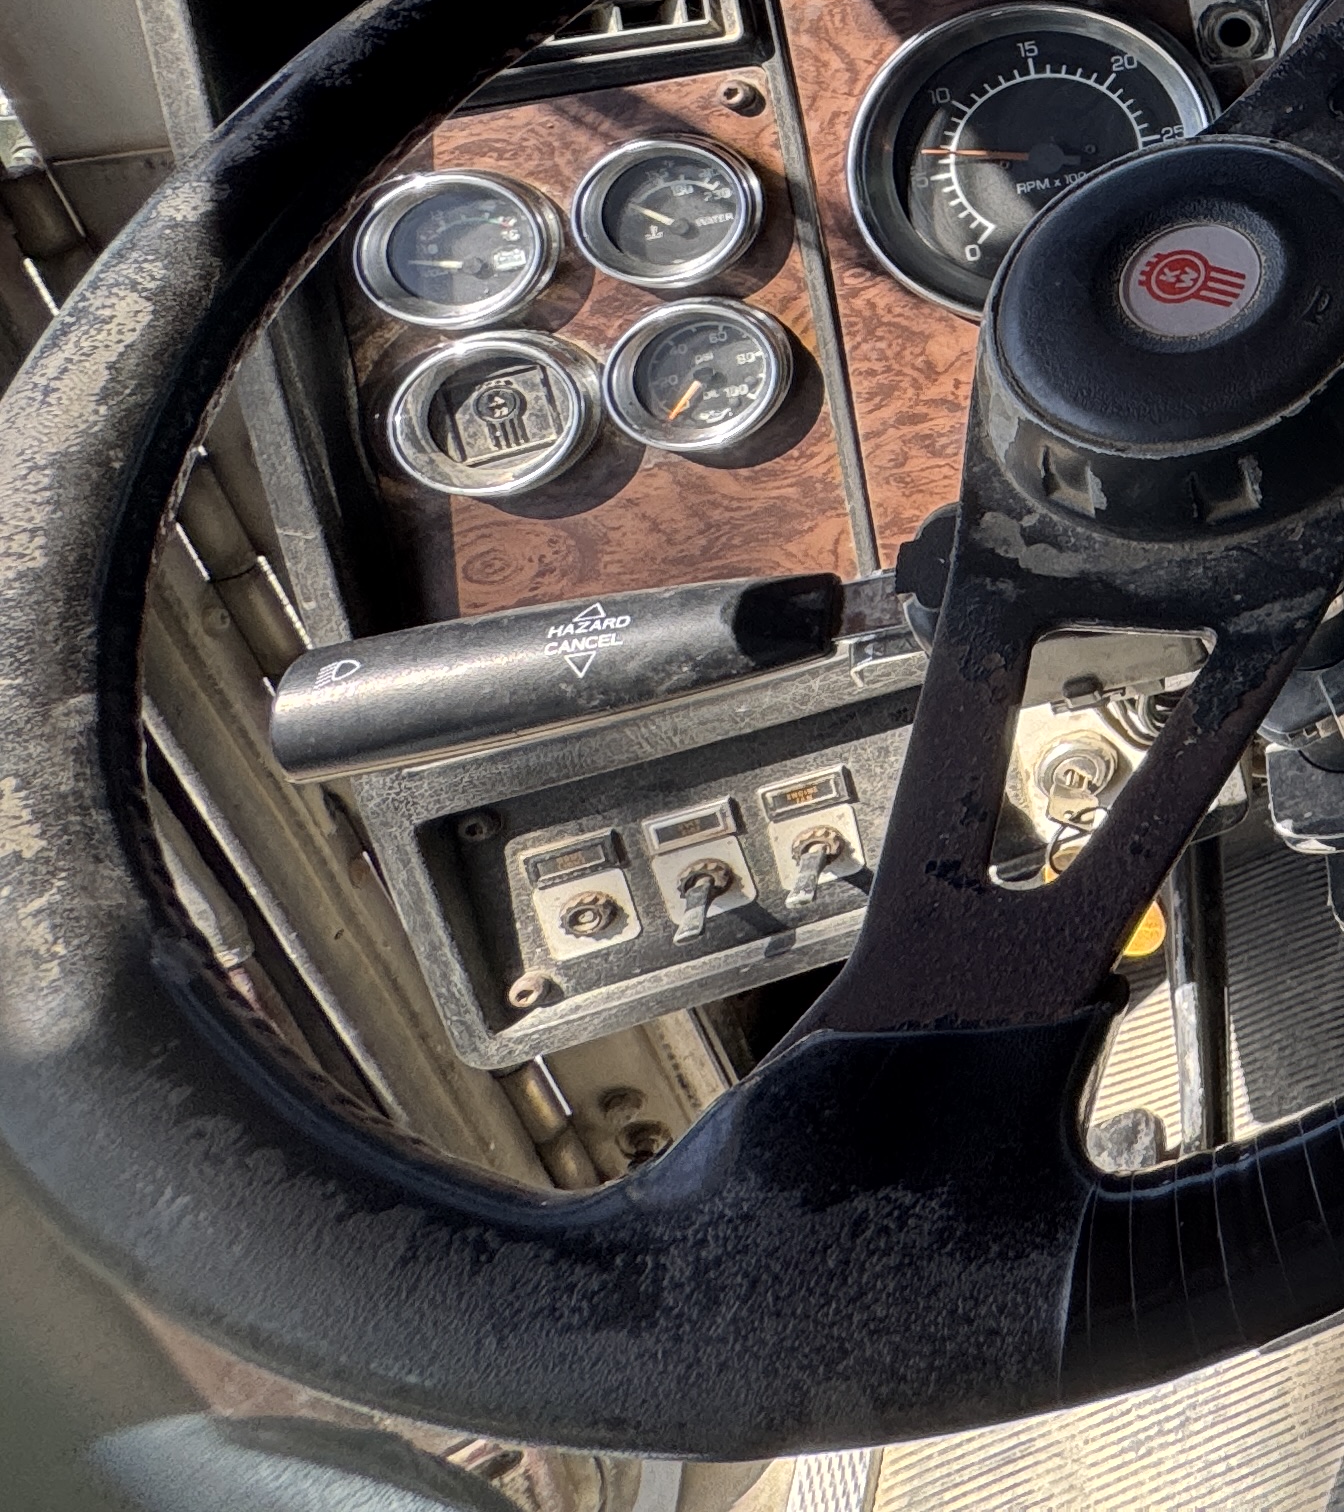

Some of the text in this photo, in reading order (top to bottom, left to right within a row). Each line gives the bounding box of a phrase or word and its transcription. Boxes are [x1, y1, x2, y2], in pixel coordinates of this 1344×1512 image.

[1017, 40, 1039, 57] 15
[1110, 54, 1138, 72] 20
[929, 88, 951, 104] 10
[1160, 125, 1185, 141] 25
[1016, 177, 1050, 194] RPM
[1053, 178, 1061, 187] x
[695, 212, 734, 227] WATER
[964, 244, 981, 261] 0
[709, 331, 727, 344] 60
[736, 352, 755, 365] 80
[724, 384, 749, 398] 100
[546, 615, 631, 638] HAZARD
[544, 633, 623, 655] CANCEL
